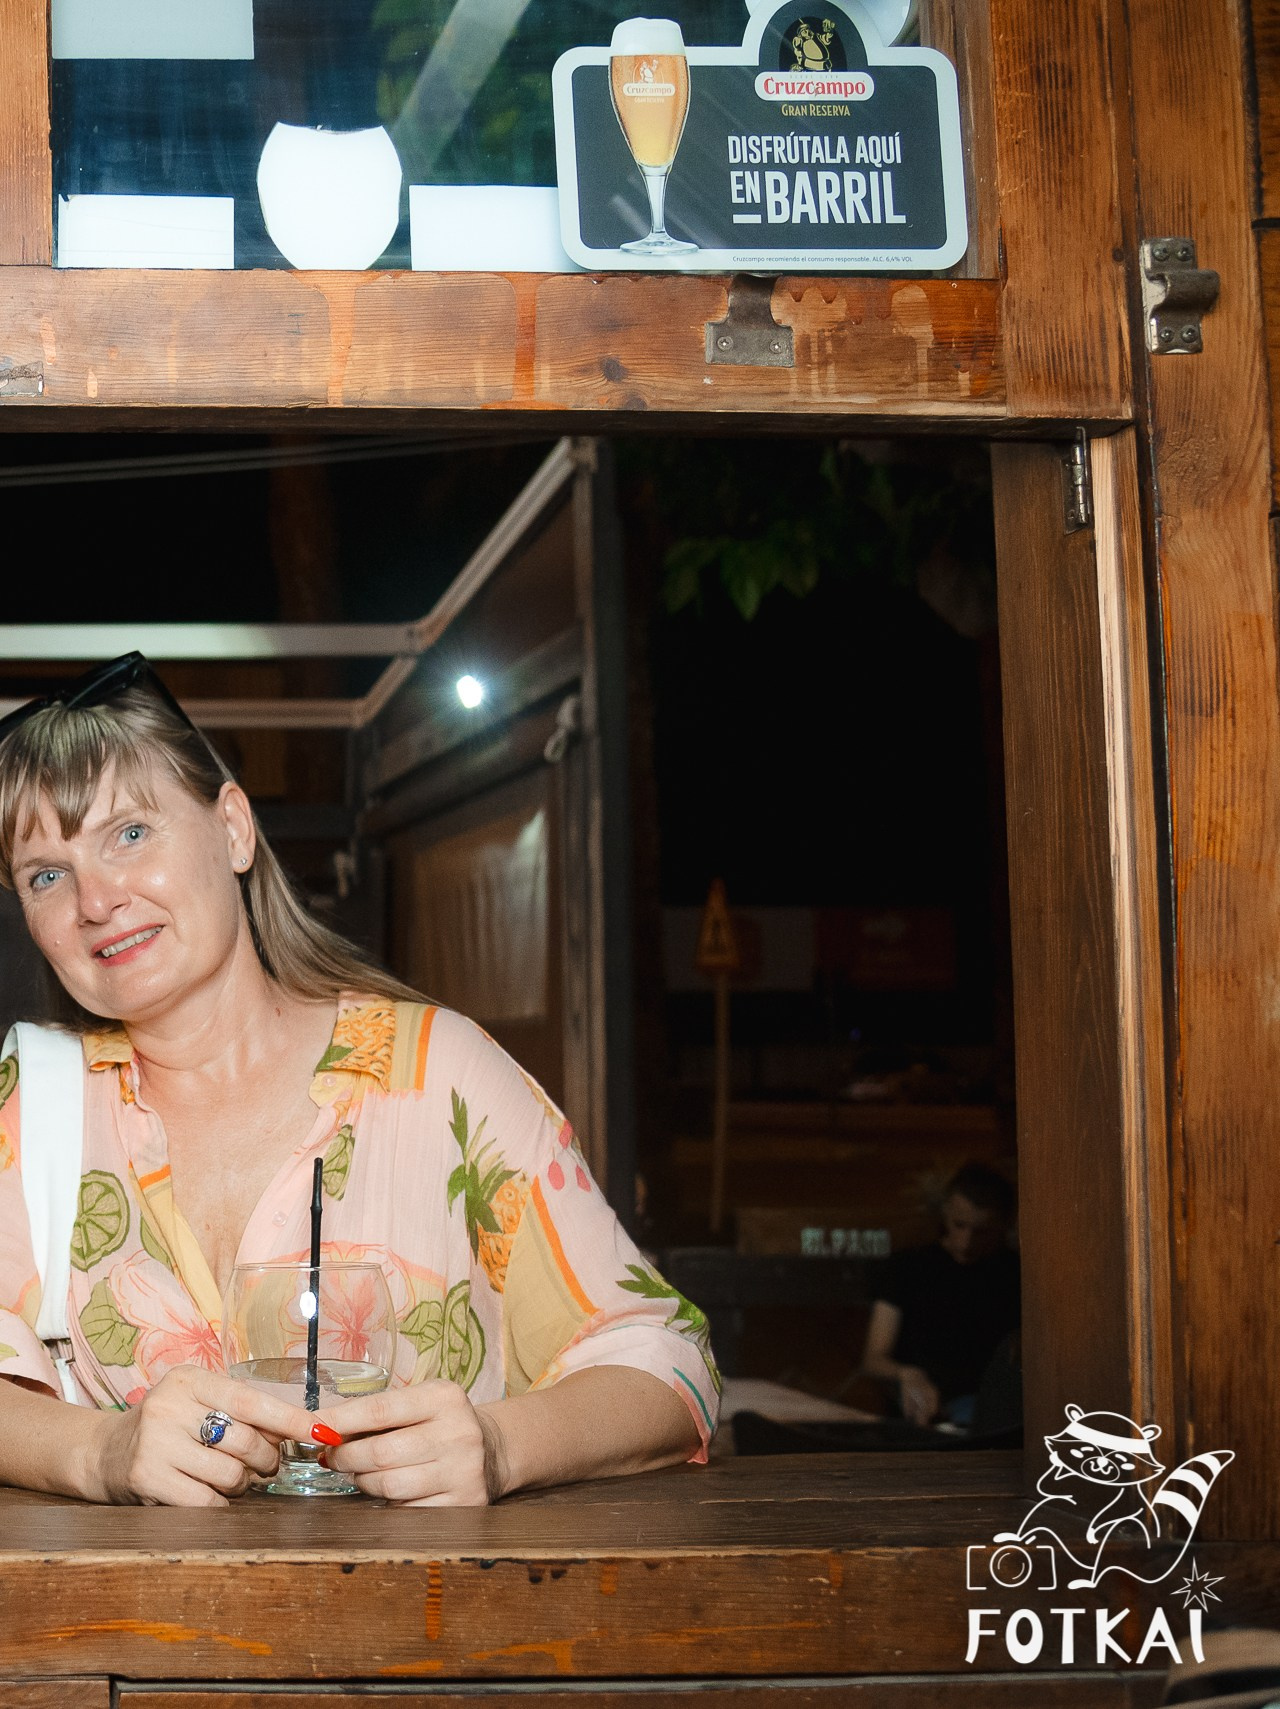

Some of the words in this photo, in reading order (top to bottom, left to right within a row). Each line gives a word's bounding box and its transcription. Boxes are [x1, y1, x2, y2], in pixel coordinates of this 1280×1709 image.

[763, 76, 866, 98] Cruzcampo
[781, 103, 808, 117] GRAN
[809, 103, 851, 117] RESERVA
[727, 131, 851, 164] DISFRÚTALA
[855, 131, 902, 168] AQUÍ
[730, 170, 761, 204] EN
[764, 170, 907, 224] BARRIL
[732, 255, 765, 263] Cruzcampo
